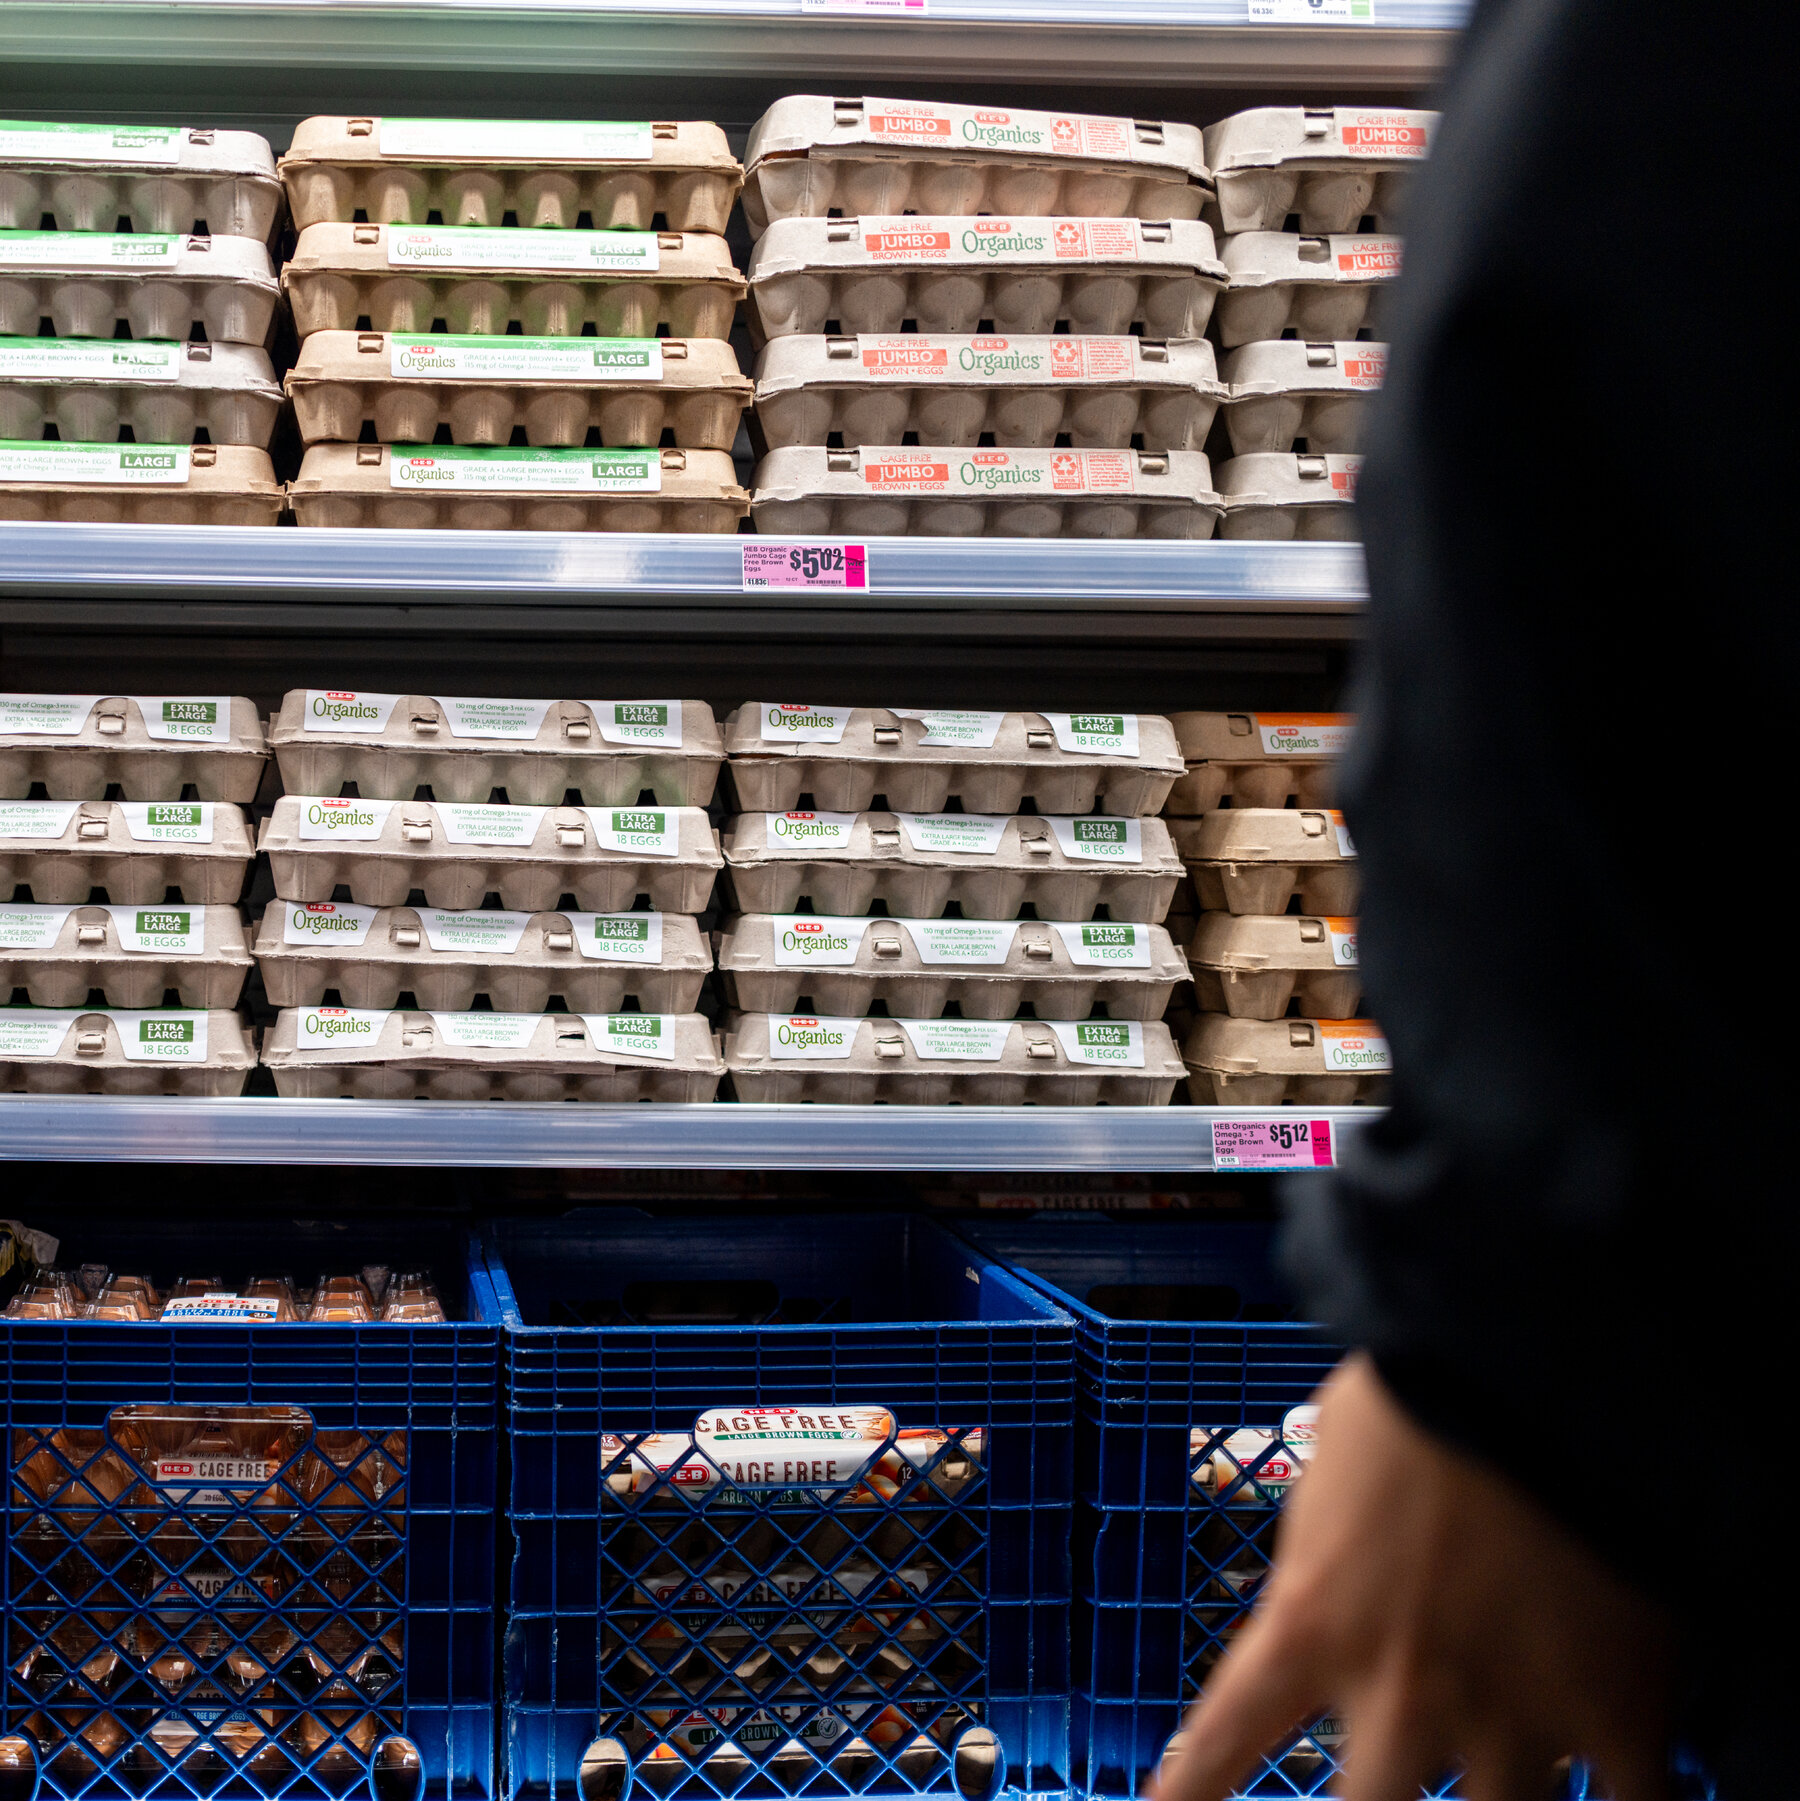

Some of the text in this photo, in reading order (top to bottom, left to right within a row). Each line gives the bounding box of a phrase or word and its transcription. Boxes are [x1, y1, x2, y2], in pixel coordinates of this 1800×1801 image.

[884, 107, 934, 117] CAGE FREE
[883, 118, 938, 132] JUMBO
[1357, 116, 1408, 126] CAGE FREE
[962, 119, 1043, 146] Organics
[1356, 129, 1411, 144] JUMBO
[876, 134, 948, 144] BROWN EGGS
[1348, 146, 1422, 155] BROWN EGGS
[911, 223, 932, 232] FREE
[879, 234, 936, 250] JUMBO
[962, 230, 1044, 258] Organics
[1352, 242, 1379, 252] CAGE
[397, 240, 453, 260] Organics
[595, 245, 642, 254] LARGE
[872, 250, 947, 260] BROWN EGGS
[595, 257, 640, 266] 12 EGGS
[878, 339, 930, 348] CAGE FREE
[400, 352, 456, 372] Organics
[598, 354, 645, 365] LARGE
[876, 351, 933, 366] JUMBO
[959, 347, 1042, 376] Organics
[870, 366, 944, 375] BROWN EGGS
[125, 457, 172, 467] LARGE
[880, 454, 932, 463] CAGE FREE
[400, 464, 455, 483] Organics
[598, 466, 643, 476] LARGE
[878, 466, 935, 480] JUMBO
[960, 462, 1042, 490] Organics
[872, 482, 945, 491] BROWN EGGS
[170, 704, 208, 712] EXTRA
[313, 697, 378, 722] Organics
[622, 707, 658, 715] EXTRA
[171, 712, 207, 720] LARGE
[623, 714, 658, 722] LARGE
[768, 708, 834, 732] Organics
[1078, 716, 1114, 725] EXTRA
[166, 724, 213, 736] 18 EGGS
[619, 727, 664, 738] 18 EGGS
[1079, 724, 1115, 732] LARGE
[1076, 736, 1122, 746] 18 EGGS
[1270, 734, 1320, 752] Organics
[156, 807, 192, 816] EXTRA
[156, 814, 192, 823] LARGE
[308, 805, 374, 829] Organics
[620, 814, 656, 822] EXTRA
[620, 821, 656, 830] LARGE
[774, 817, 840, 840] Organics
[1081, 824, 1118, 832] EXTRA
[152, 828, 198, 838] 18 EGGS
[1082, 831, 1118, 840] LARGE
[616, 834, 662, 846] 18 EGGS
[1080, 844, 1124, 855] 18 EGGS
[144, 914, 181, 923] EXTRA
[293, 910, 359, 934] Organics
[144, 922, 181, 931] LARGE
[602, 920, 639, 930] EXTRA
[603, 928, 639, 938] LARGE
[1088, 928, 1126, 936] EXTRA
[140, 936, 186, 947] 18 EGGS
[782, 931, 848, 954] Organics
[1090, 934, 1126, 943] LARGE
[600, 942, 645, 954] 18 EGGS
[1089, 949, 1134, 958] 18 EGGS
[306, 1014, 371, 1038] Organics
[616, 1018, 652, 1026] EXTRA
[147, 1023, 184, 1032] EXTRA
[616, 1024, 652, 1034] LARGE
[1084, 1027, 1121, 1036] EXTRA
[148, 1030, 184, 1040] LARGE
[778, 1025, 843, 1050] Organics
[1086, 1034, 1121, 1044] LARGE
[612, 1037, 658, 1050] 18 EGGS
[143, 1045, 189, 1056] 18 EGGS
[1084, 1048, 1128, 1059] 18 EGGS
[1333, 1048, 1386, 1067] Organics
[1232, 1122, 1266, 1130] Organics
[694, 1414, 856, 1433] CAGE FREE
[808, 1432, 835, 1440] EGGS
[200, 1462, 270, 1478] CAGE FREE
[720, 1460, 837, 1483] CAGE FREE
[902, 1466, 912, 1479] 12
[232, 1712, 246, 1720] EGGS
[740, 1726, 778, 1740] BROWN
